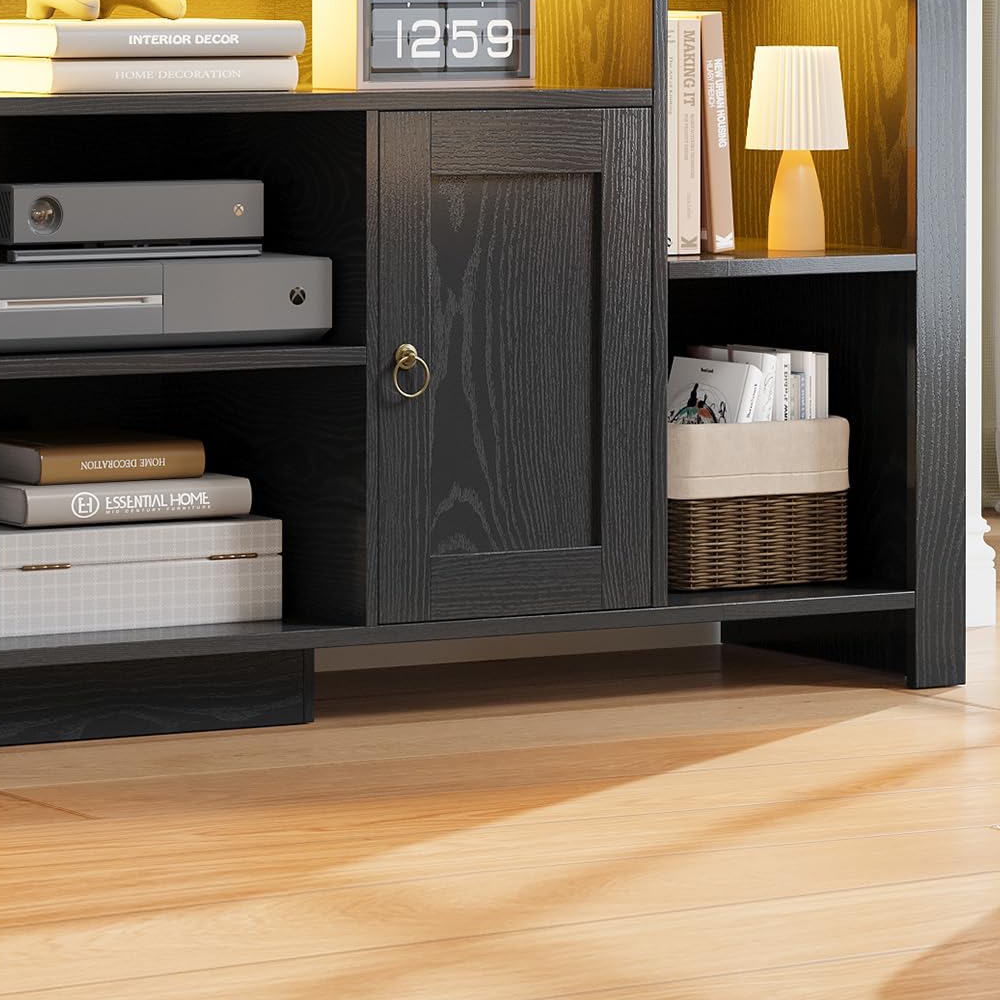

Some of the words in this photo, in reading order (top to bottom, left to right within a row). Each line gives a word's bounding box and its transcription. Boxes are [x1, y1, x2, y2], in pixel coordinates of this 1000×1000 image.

[128, 33, 192, 46] INTERIOR
[194, 33, 240, 45] DECOR
[683, 30, 696, 90] MAKING
[714, 57, 724, 78] NEW
[114, 71, 154, 81] HOME
[157, 70, 241, 80] DECORATION
[683, 92, 696, 107] IT
[715, 78, 726, 109] URBAN
[716, 109, 728, 148] HOUSING
[80, 458, 137, 471] DECORATION
[139, 457, 166, 468] HOME
[105, 493, 168, 510] ESSENTIAL
[169, 491, 211, 506] HOME
